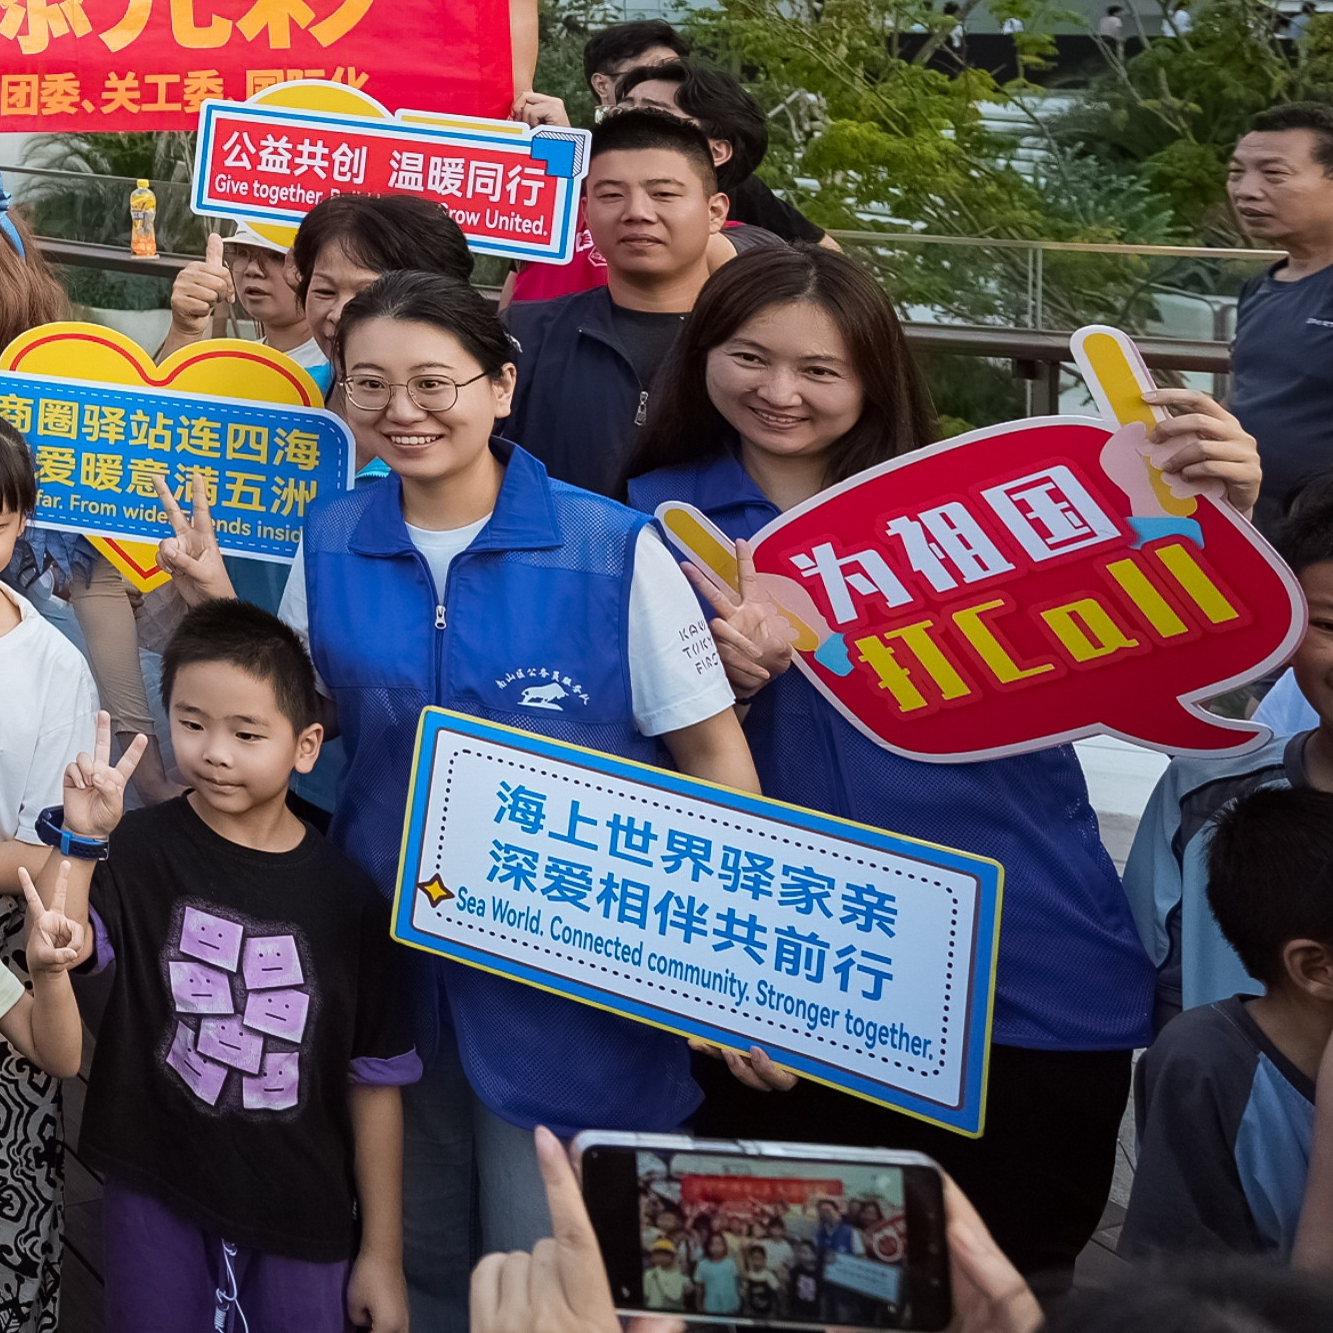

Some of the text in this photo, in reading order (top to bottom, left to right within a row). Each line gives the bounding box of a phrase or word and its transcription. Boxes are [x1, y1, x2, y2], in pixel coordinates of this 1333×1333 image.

[214, 172, 249, 197] Give
[441, 202, 481, 227] row
[484, 208, 549, 236] United.
[221, 131, 546, 207] 公益共创 温暖同行
[33, 445, 318, 518] 爱暖意满五洲
[69, 494, 117, 517] From
[257, 520, 303, 544] insid
[790, 464, 1122, 625] 为祖国
[492, 780, 899, 939] 海上世界驿家亲
[456, 886, 934, 1061] Sea World. Connected community. Stronger together.
[485, 838, 894, 1002] 深爱相伴共前行
